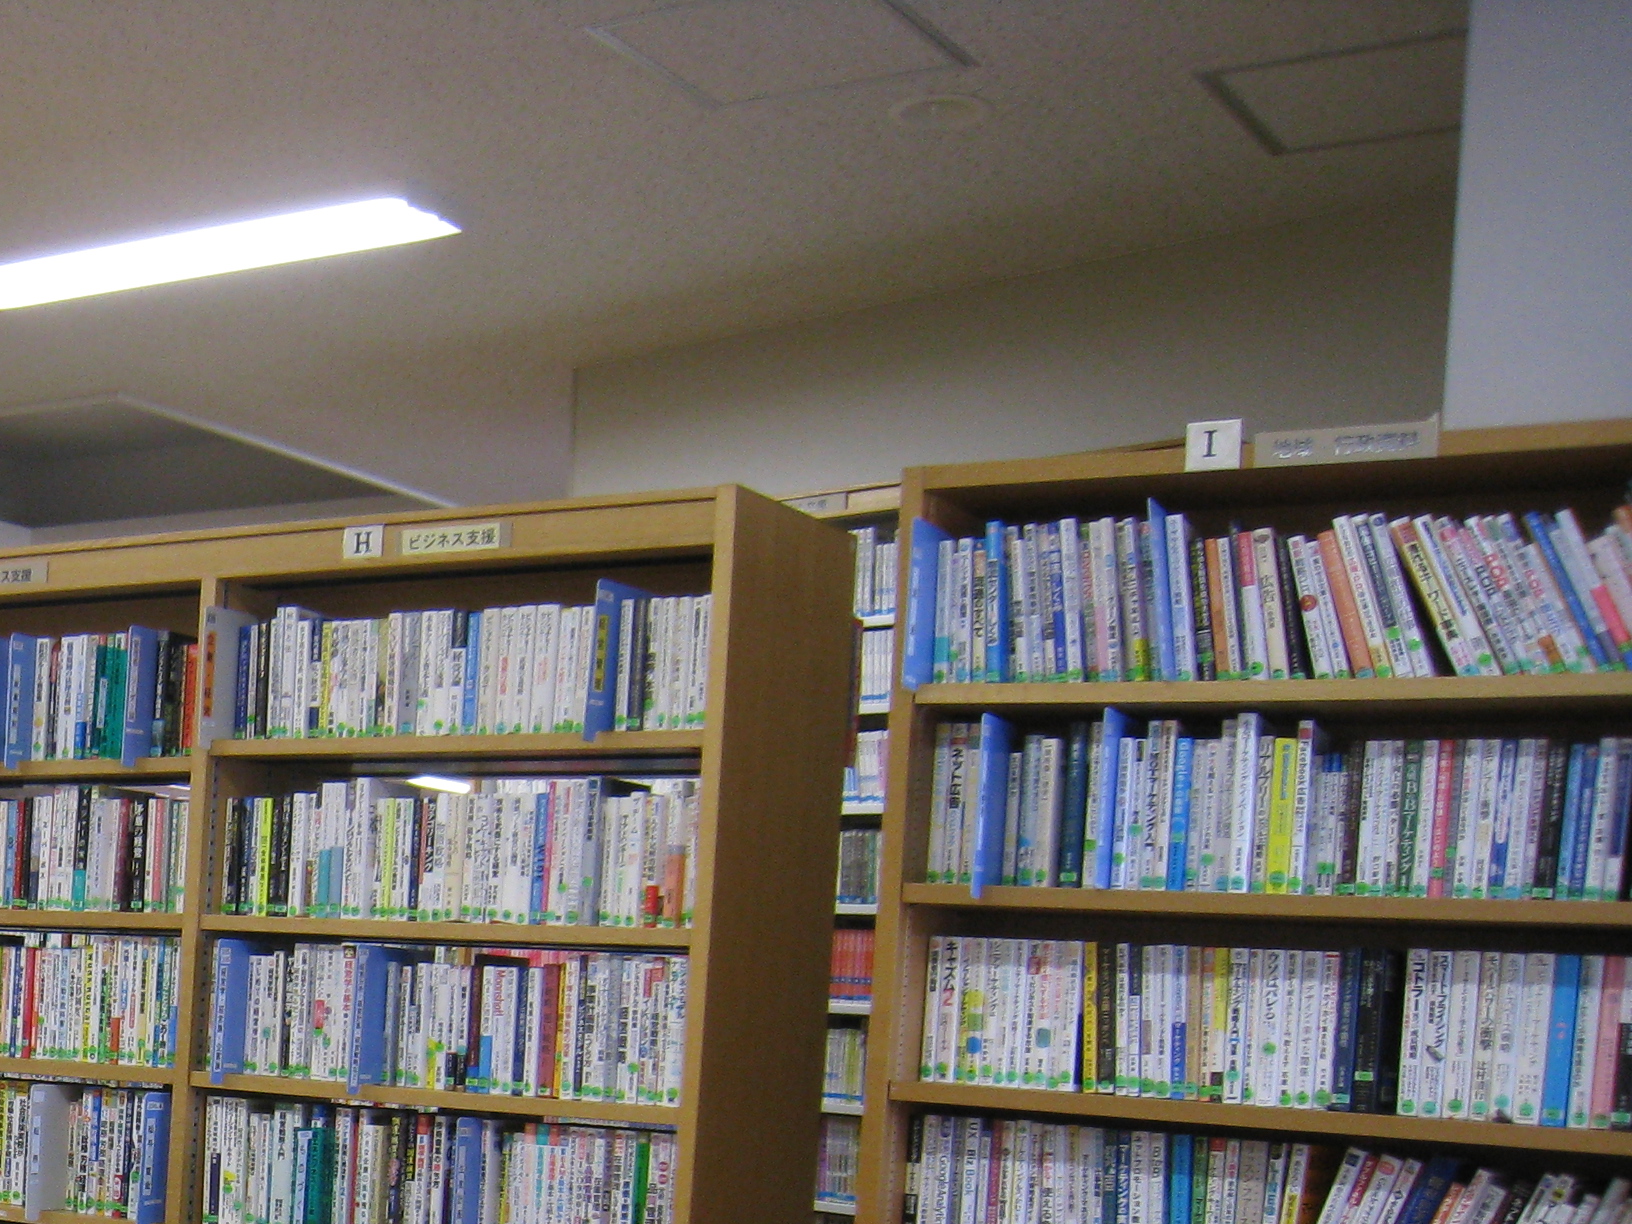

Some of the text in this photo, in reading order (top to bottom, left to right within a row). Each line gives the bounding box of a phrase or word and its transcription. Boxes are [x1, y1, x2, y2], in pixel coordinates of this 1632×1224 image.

[1202, 429, 1219, 458] I
[354, 531, 372, 555] H
[409, 528, 497, 550] ビジネス支援
